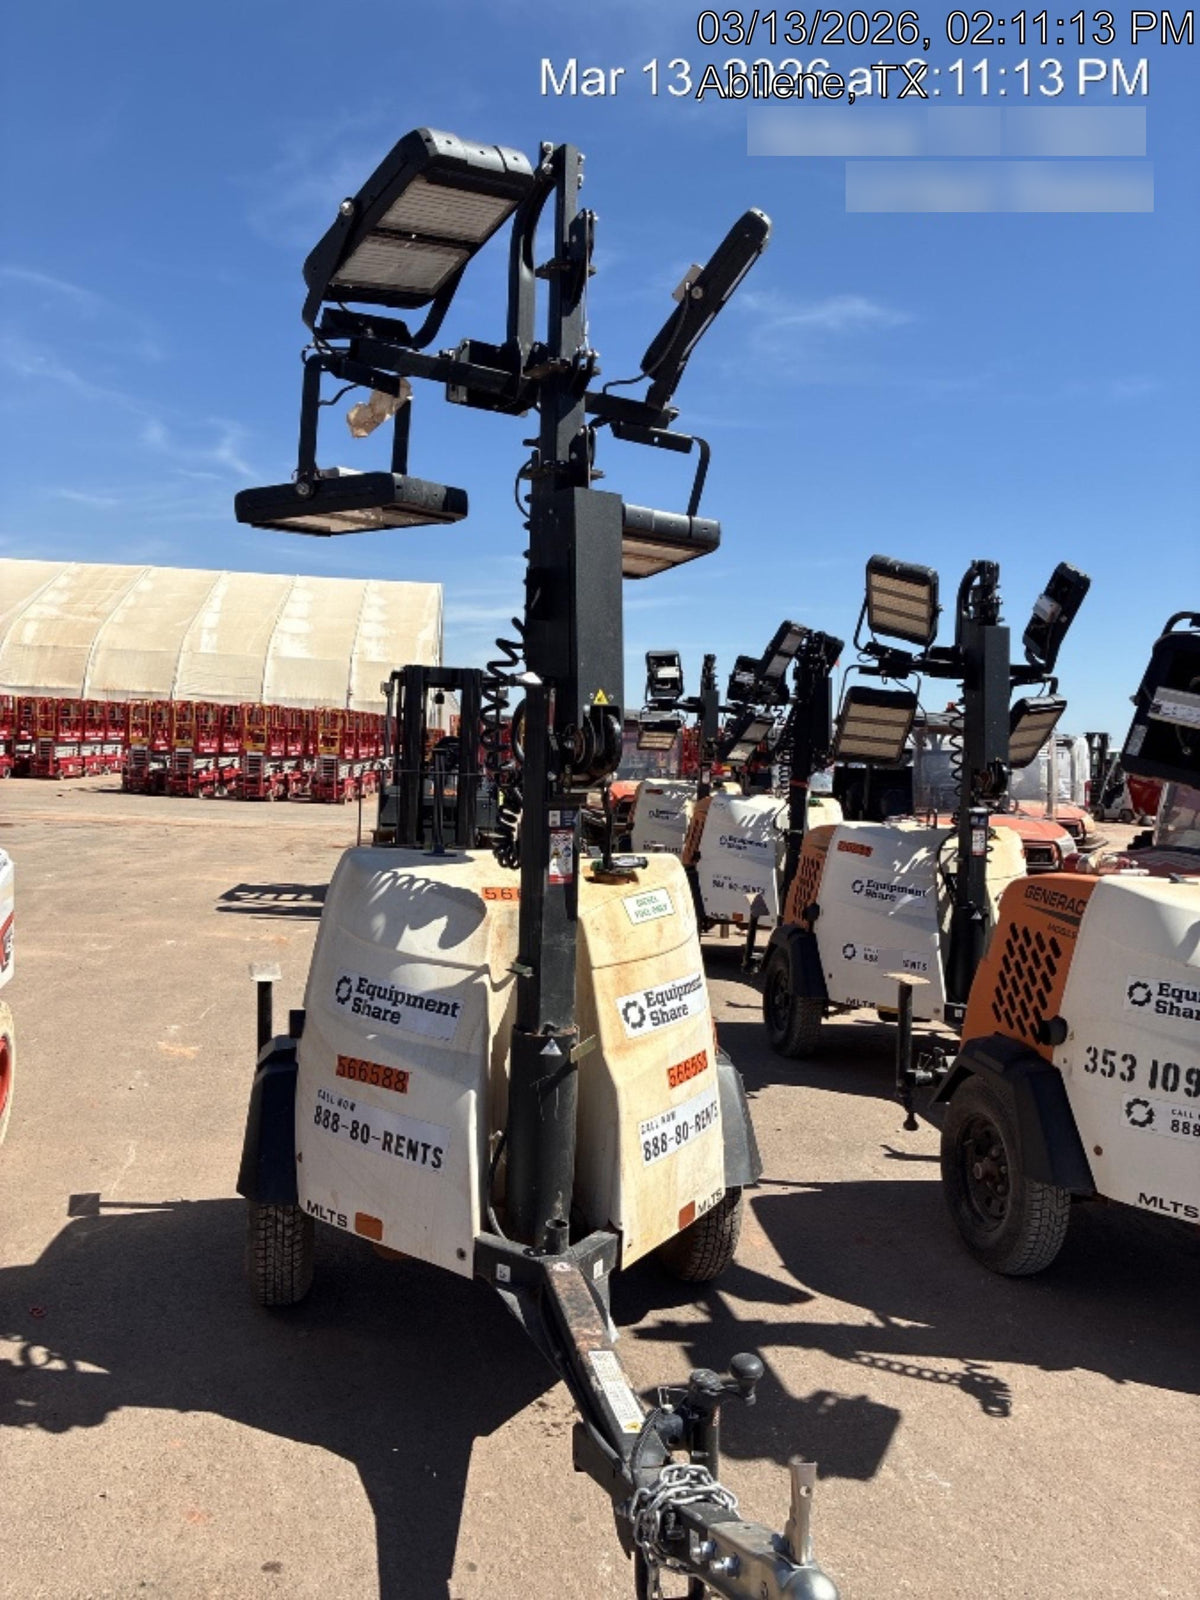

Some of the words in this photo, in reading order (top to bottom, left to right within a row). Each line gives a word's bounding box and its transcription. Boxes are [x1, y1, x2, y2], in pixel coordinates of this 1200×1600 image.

[1024, 884, 1086, 915] GENERAC
[351, 996, 402, 1025] Share
[355, 977, 461, 1018] Equipment
[649, 1003, 689, 1028] Share
[337, 1056, 408, 1094] 566588
[1084, 1045, 1137, 1083] 353
[317, 1088, 335, 1105] CALL
[336, 1096, 356, 1112] NOW
[1171, 1108, 1194, 1119] CALL
[313, 1104, 443, 1169] 888-80-RENTS
[643, 1100, 719, 1162] 888-80-RENTS
[306, 1200, 348, 1228] MLTS
[1138, 1192, 1199, 1219] MLTS
